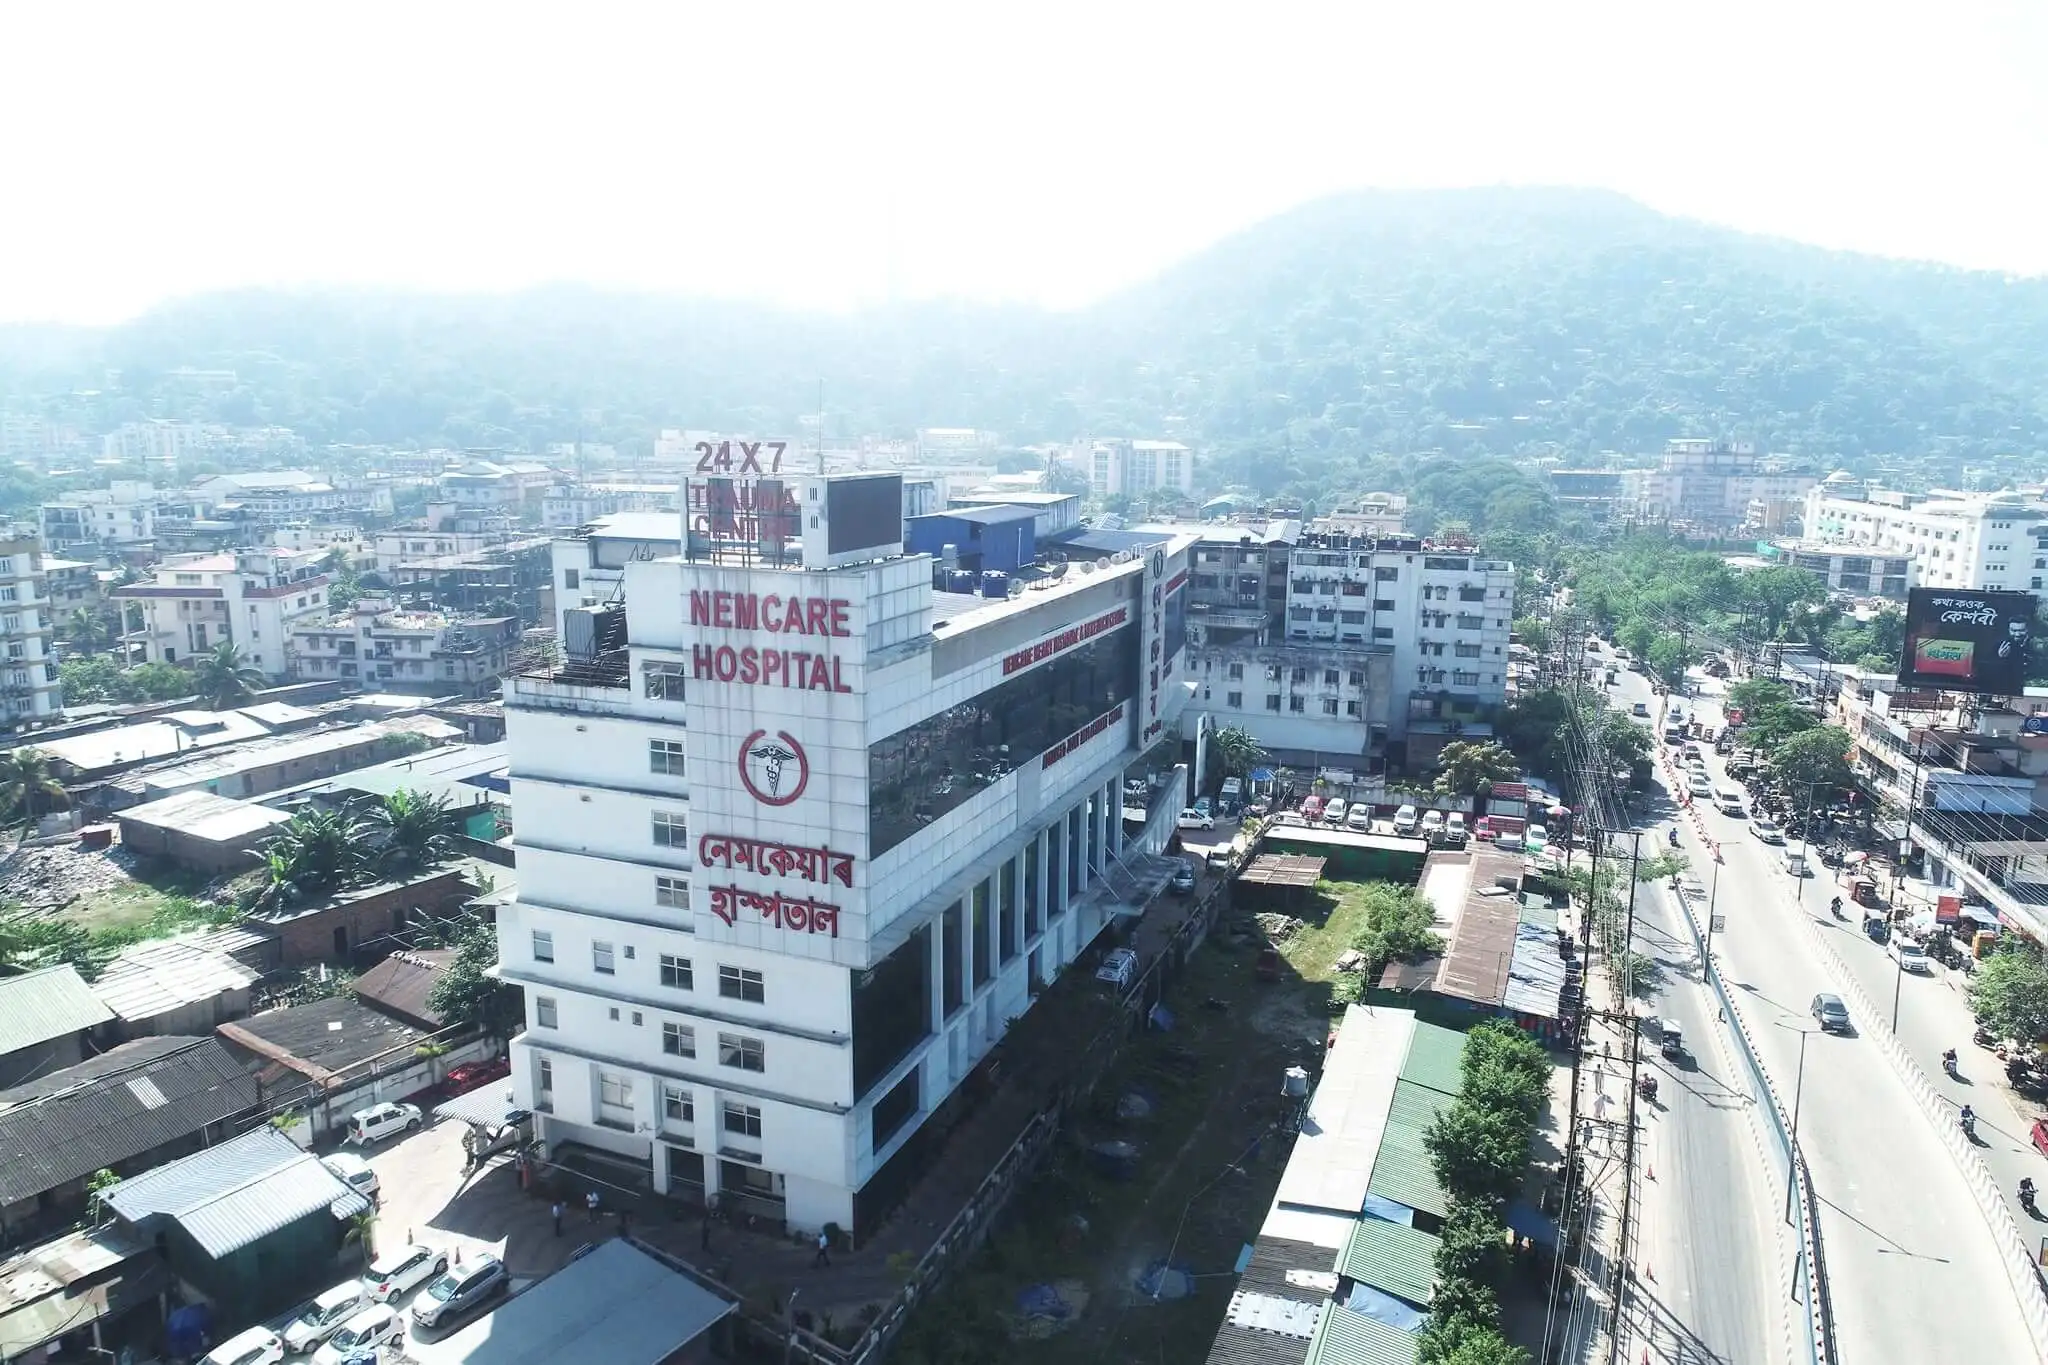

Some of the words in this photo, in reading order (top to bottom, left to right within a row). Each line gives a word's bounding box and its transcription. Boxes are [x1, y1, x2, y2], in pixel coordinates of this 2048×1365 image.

[695, 441, 733, 472] 24
[768, 442, 786, 472] 7
[690, 589, 851, 638] NEMCARE
[693, 644, 852, 693] HOSPITAL
